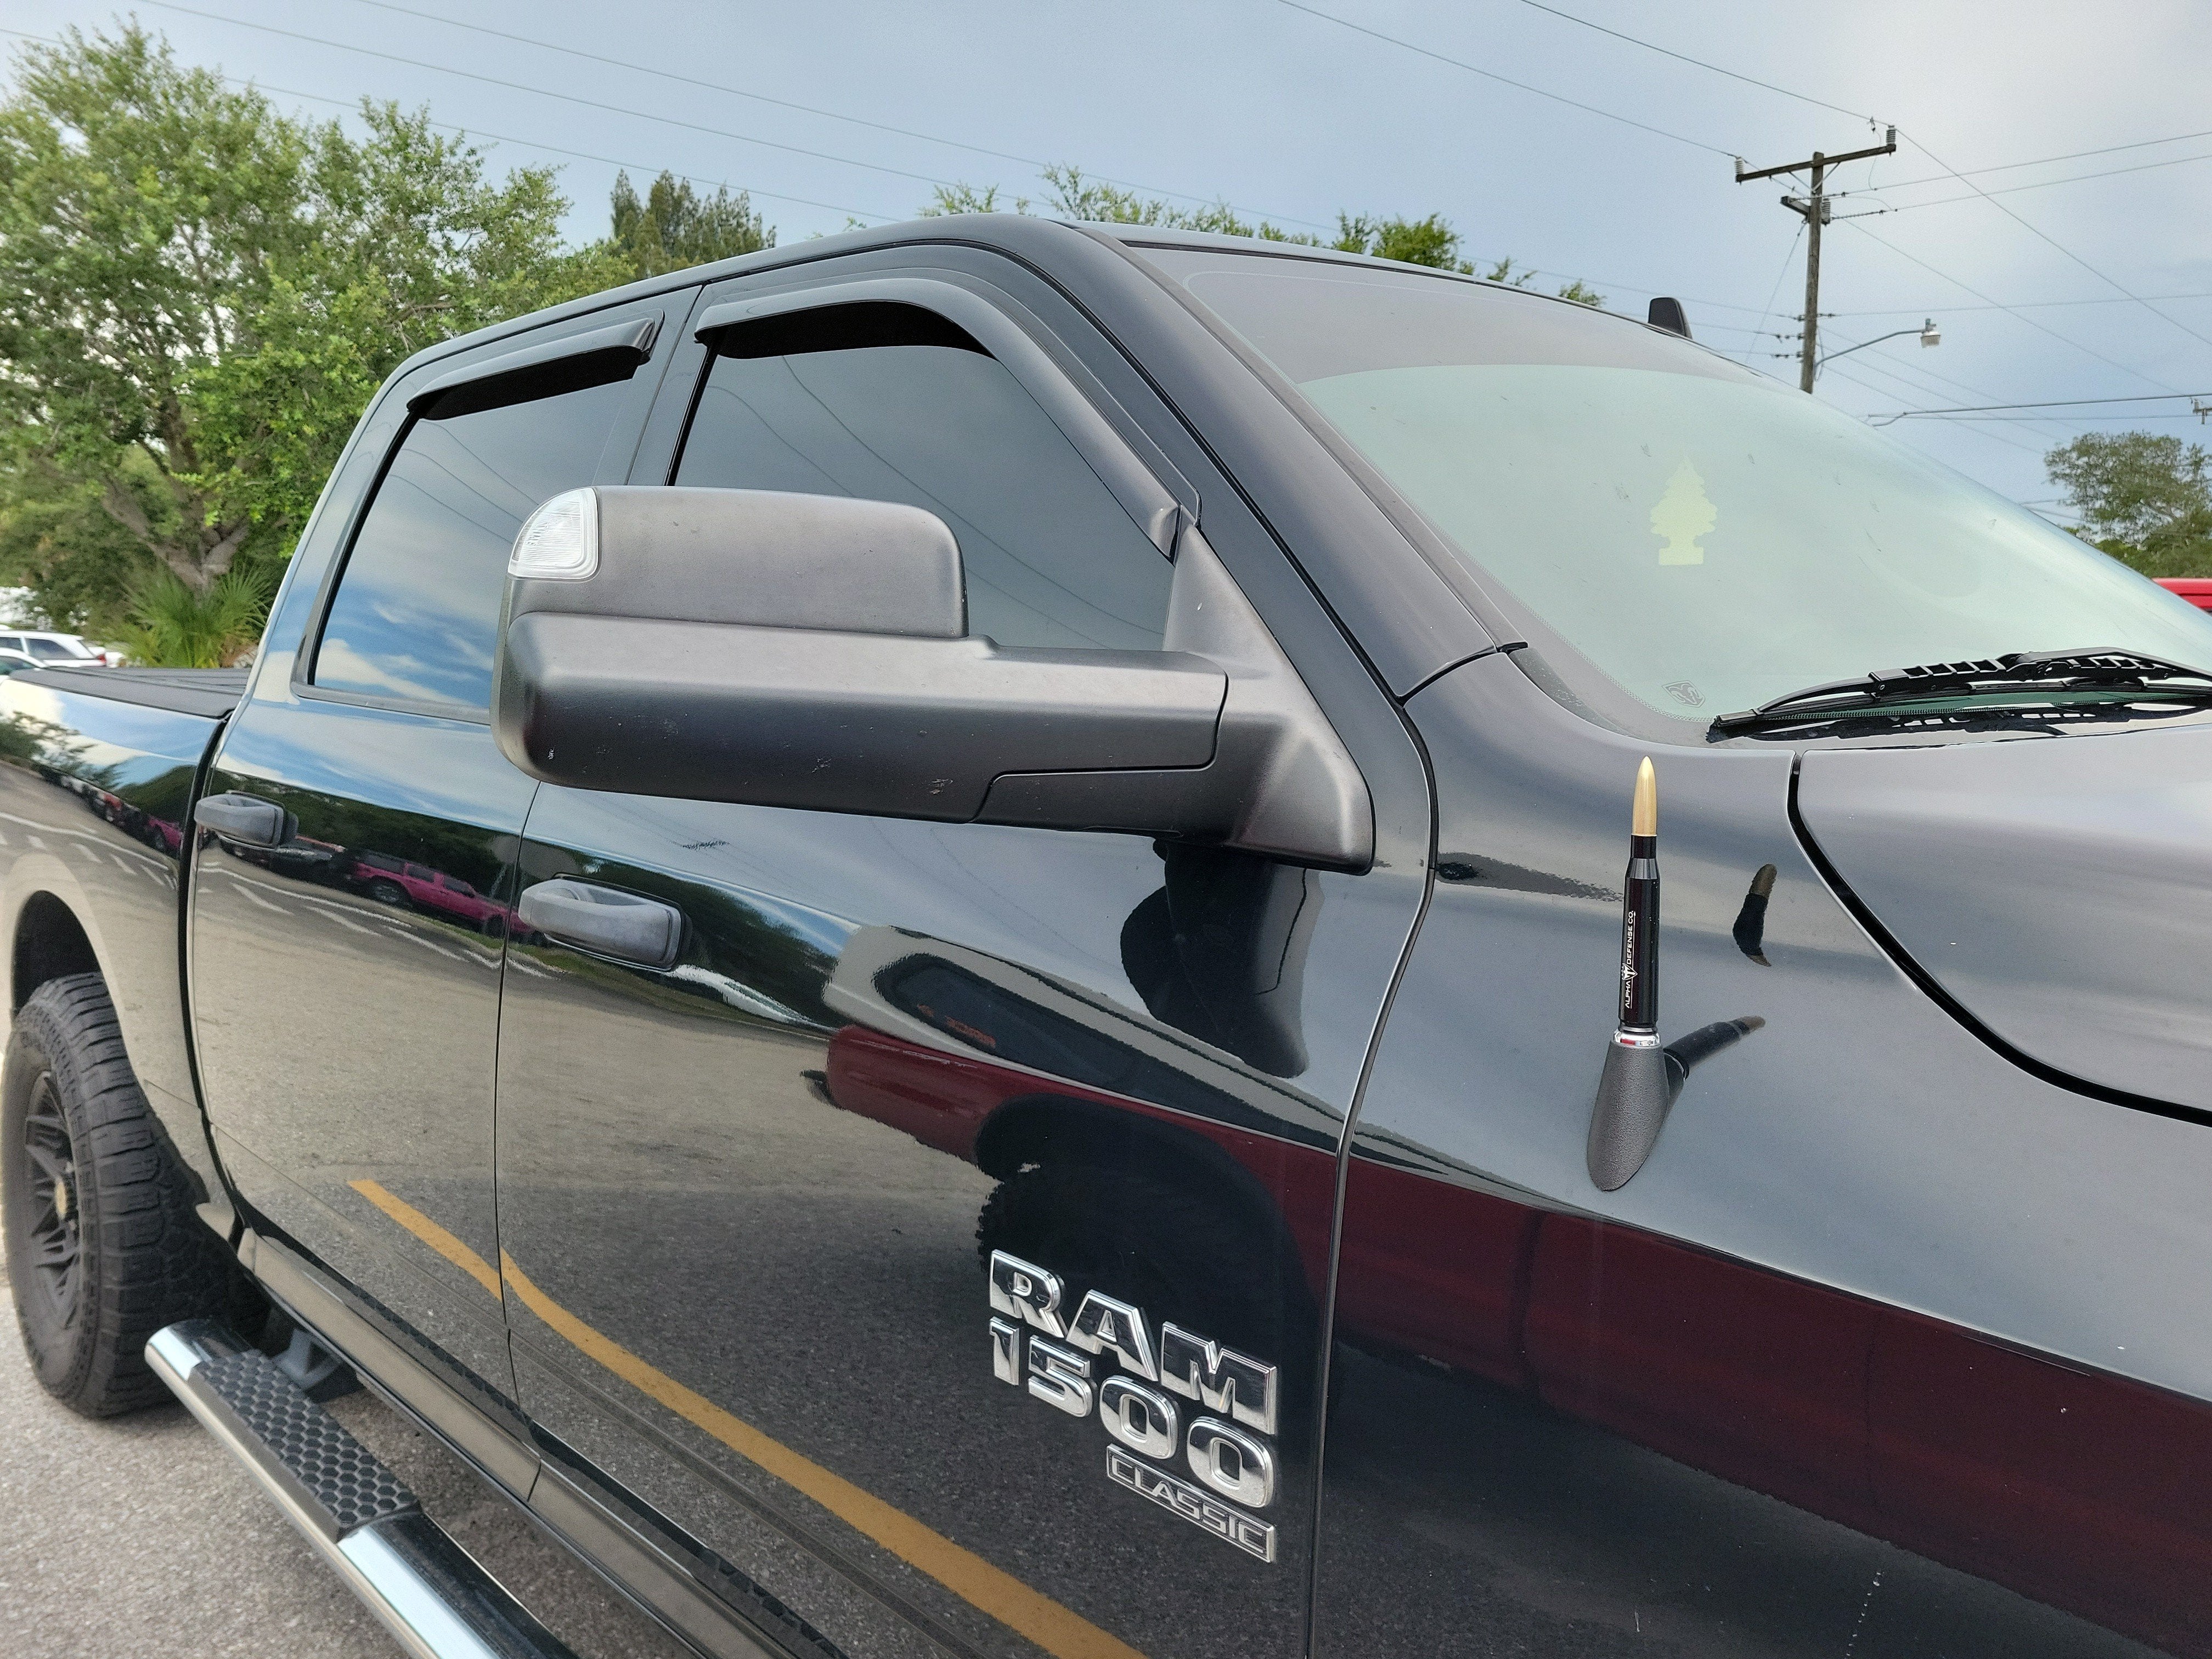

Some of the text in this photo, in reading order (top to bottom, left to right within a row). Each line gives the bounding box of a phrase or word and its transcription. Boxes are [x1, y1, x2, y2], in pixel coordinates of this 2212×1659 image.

[989, 1249, 1278, 1434] RAM
[989, 1316, 1274, 1508] 1500
[1111, 1454, 1265, 1554] CLASSIC
